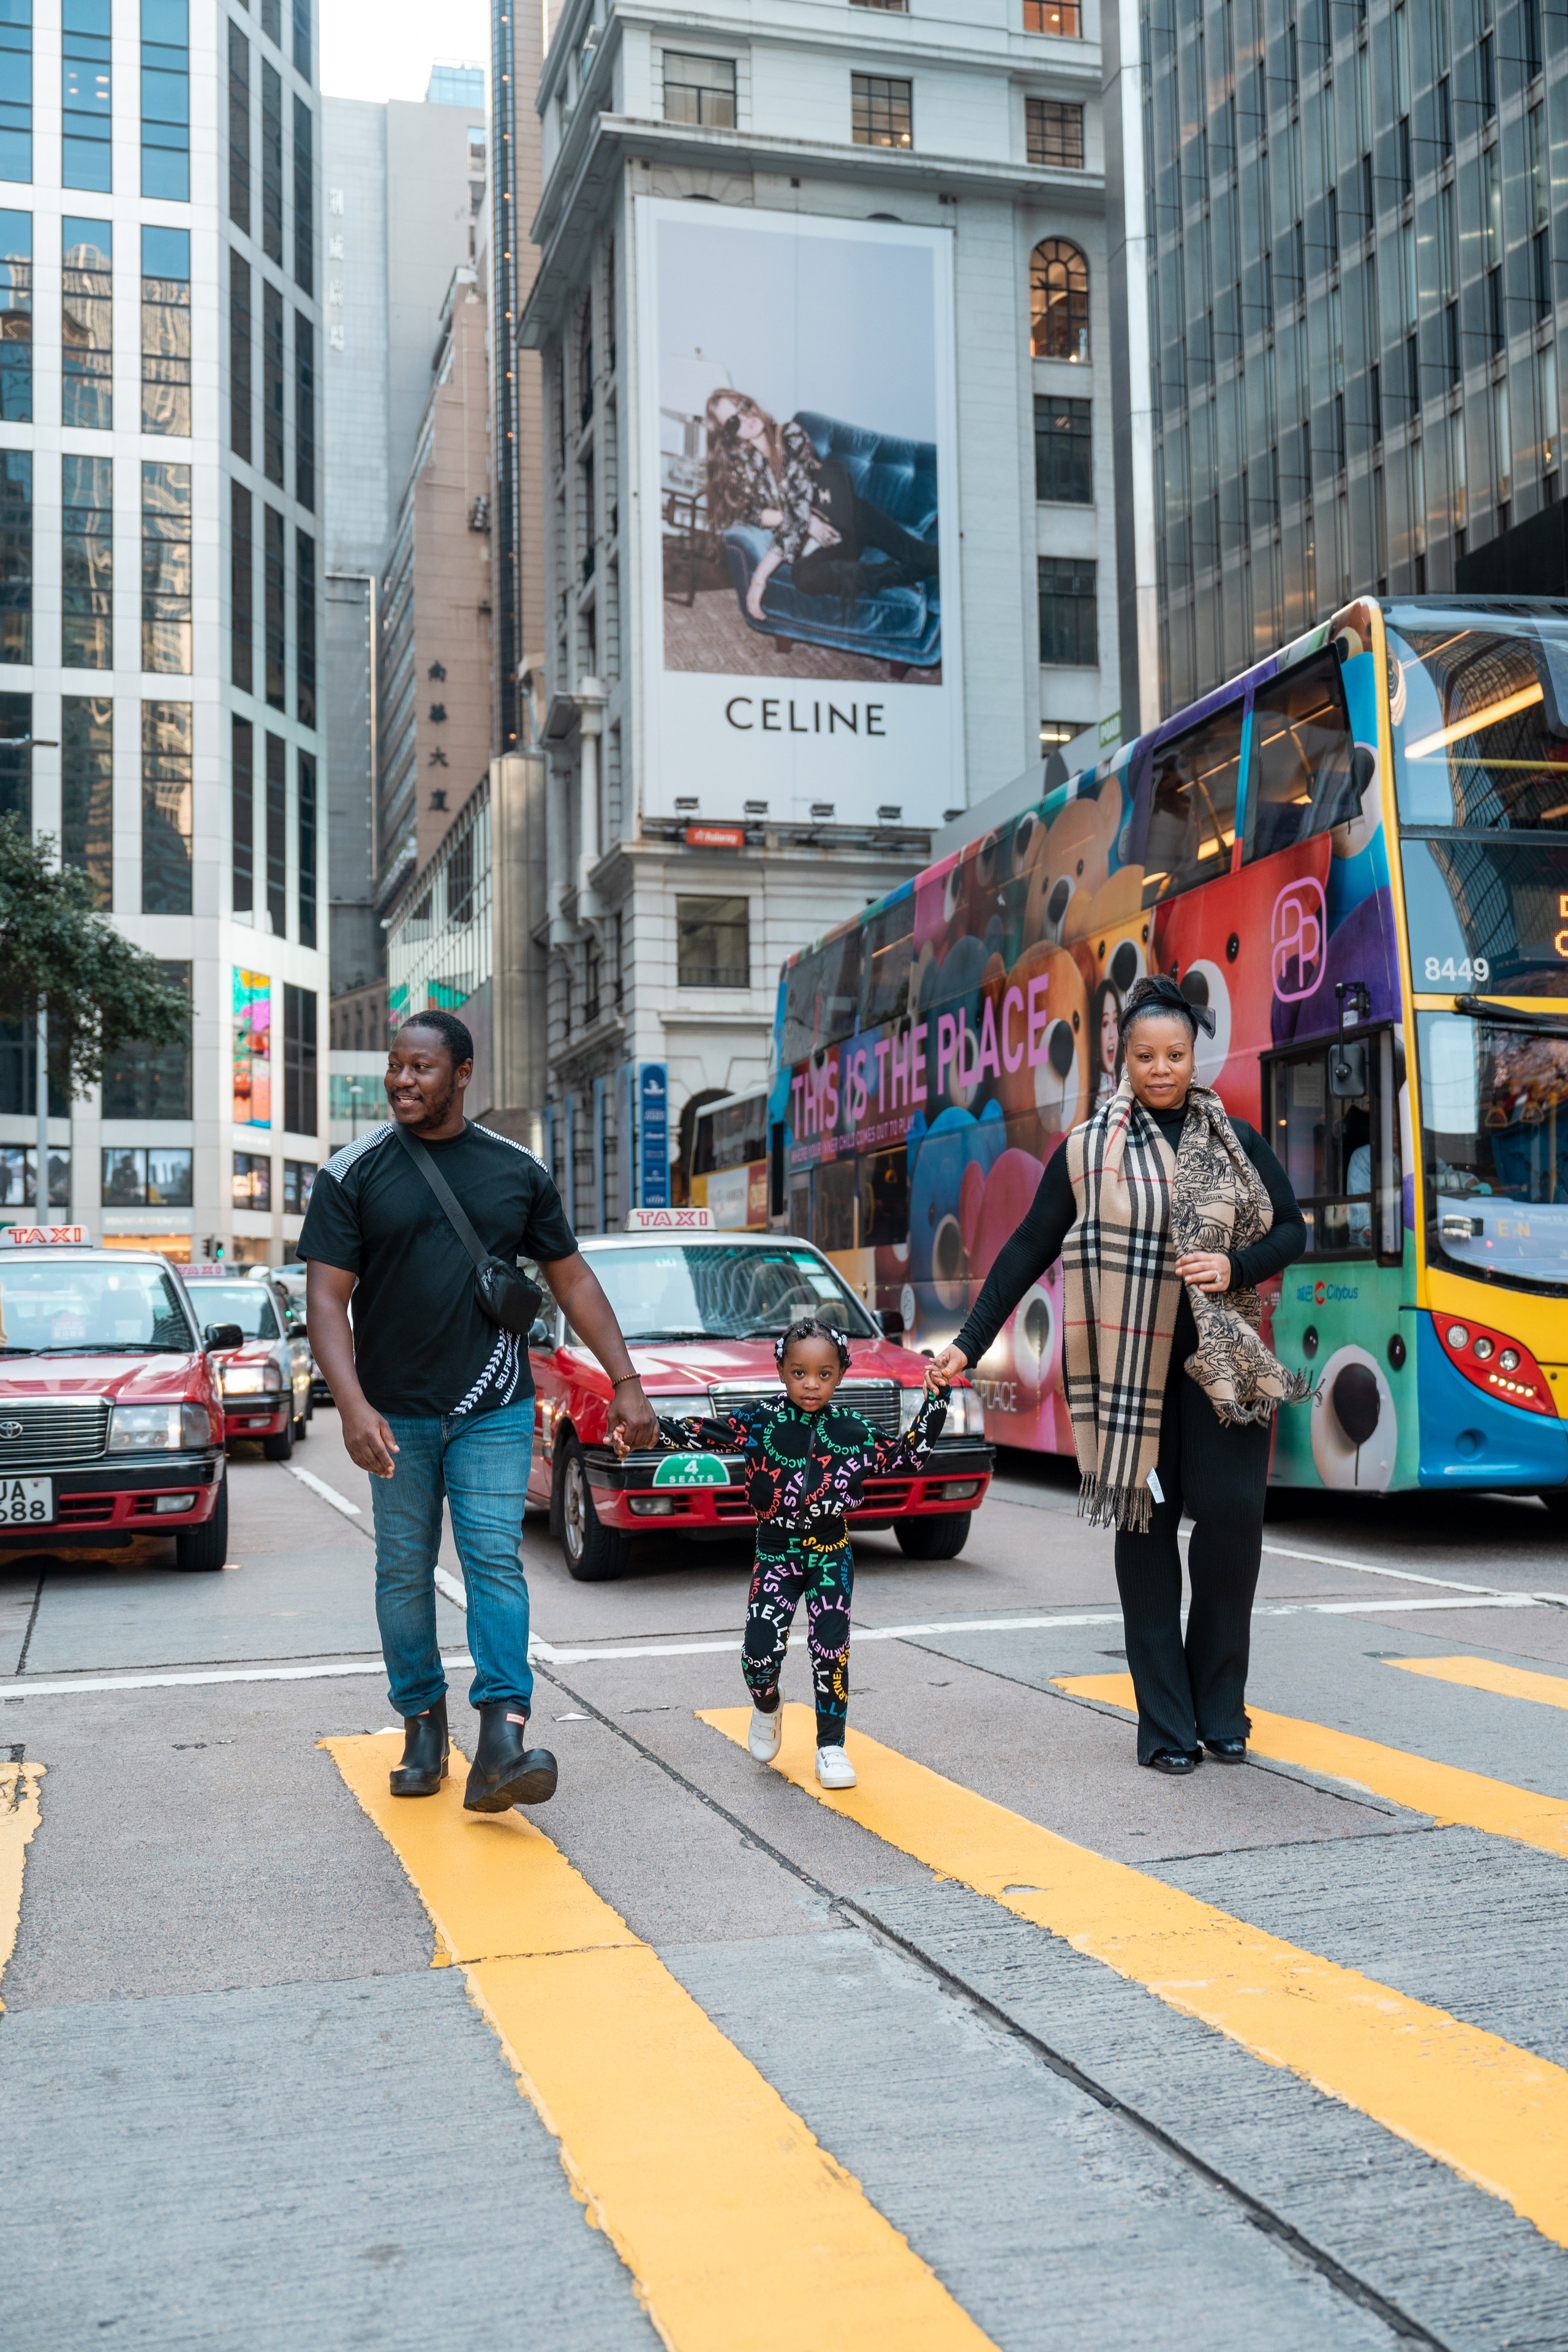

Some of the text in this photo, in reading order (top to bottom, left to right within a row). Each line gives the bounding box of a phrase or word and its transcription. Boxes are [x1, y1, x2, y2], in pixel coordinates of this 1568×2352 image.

[726, 696, 886, 736] CELINE
[1425, 957, 1490, 982] 8449
[791, 973, 1049, 1140] THIS IS THE PLACE
[791, 1145, 808, 1163] WHERE
[808, 1142, 821, 1158] YOUR
[822, 1137, 839, 1155] INNER
[839, 1133, 855, 1150] CHILD
[856, 1127, 875, 1145] COMES
[876, 1121, 889, 1140] OUT
[889, 1120, 898, 1136] TO
[1195, 1196, 1223, 1204] PRORSUM
[636, 1212, 707, 1226] TAXI
[8, 1227, 81, 1243] TAXI
[178, 1265, 222, 1275] TAXI
[1327, 1284, 1359, 1302] Citybus
[495, 1365, 510, 1390] SELF
[980, 1379, 1017, 1412] PLACE
[684, 1460, 699, 1475] 4
[669, 1475, 714, 1483] SEATS
